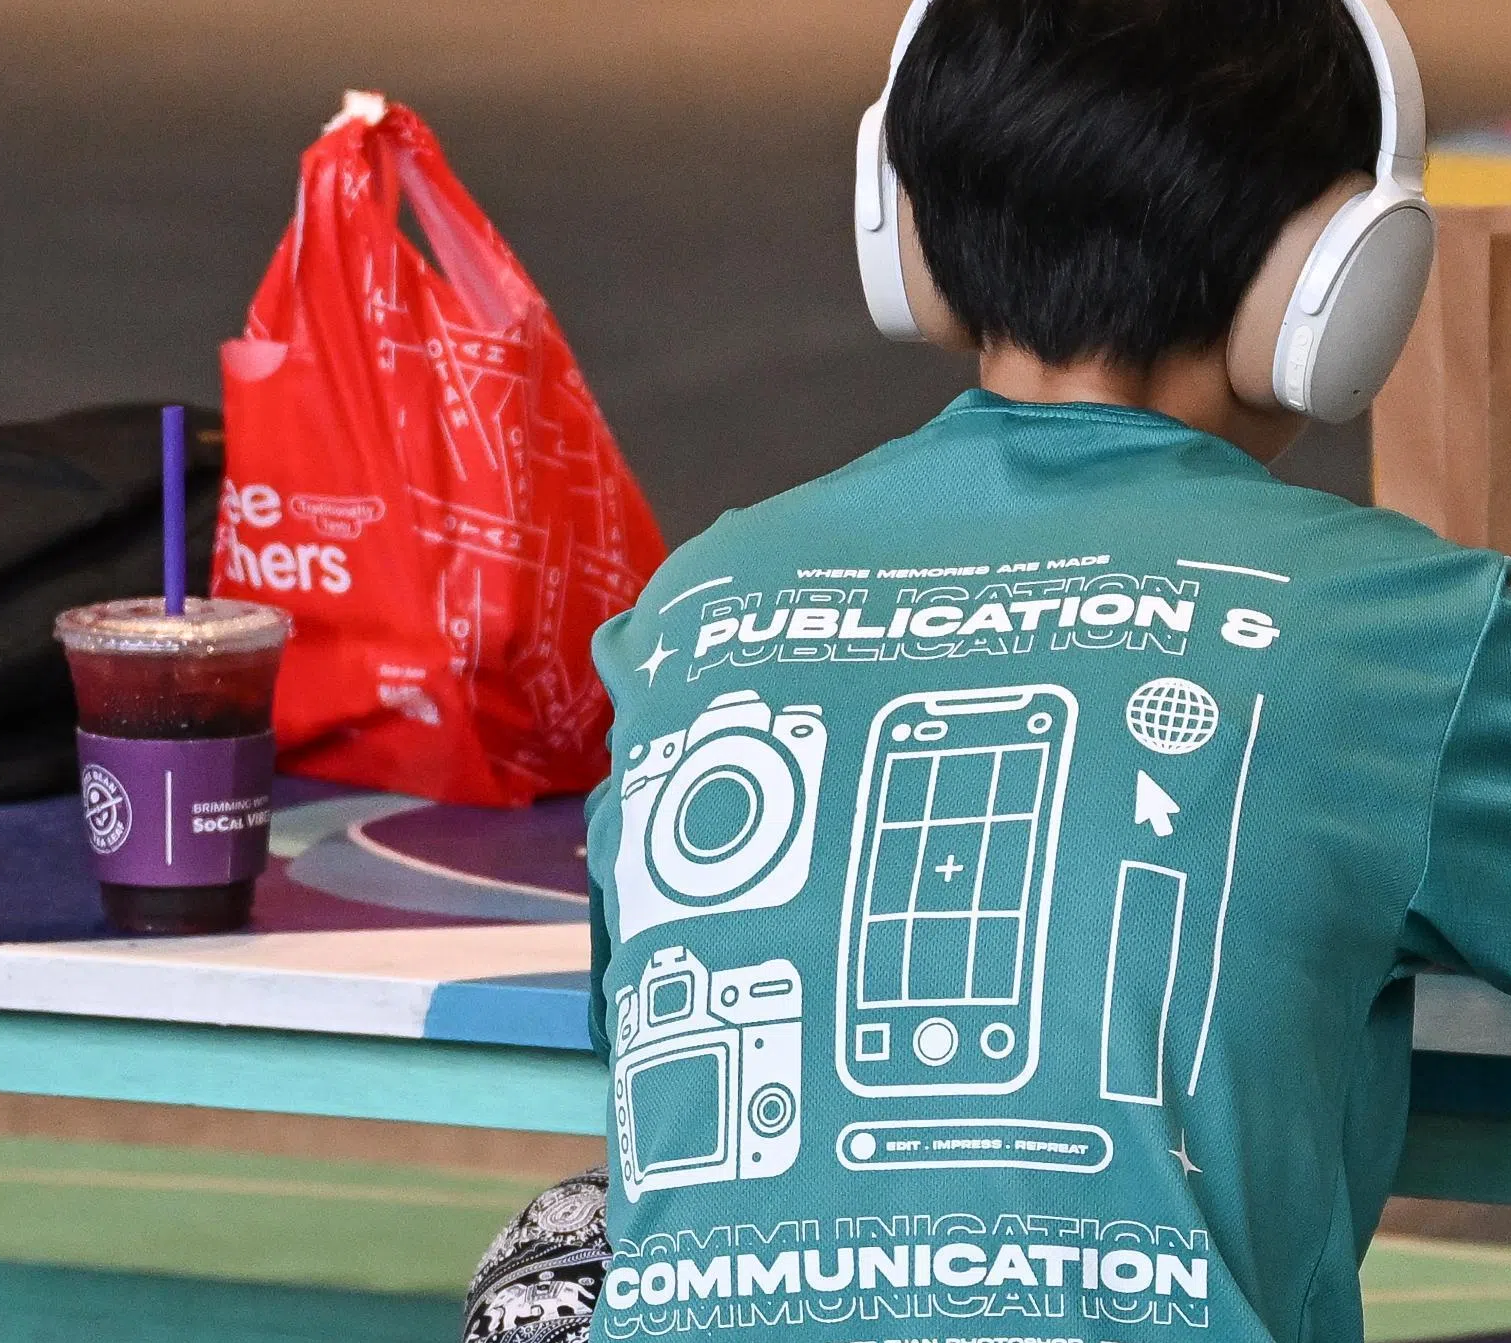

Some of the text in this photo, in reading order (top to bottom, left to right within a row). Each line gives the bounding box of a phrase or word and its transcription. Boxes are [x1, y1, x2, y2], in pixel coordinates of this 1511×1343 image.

[224, 526, 352, 594] hers
[797, 554, 1111, 579] WHERE MEMORIES ARE MADE
[693, 593, 1280, 658] PUBLICATION &
[886, 1140, 922, 1152] EDIT
[932, 1138, 1003, 1151] IMPRESS
[604, 1243, 1207, 1311] COMMUNICATION
